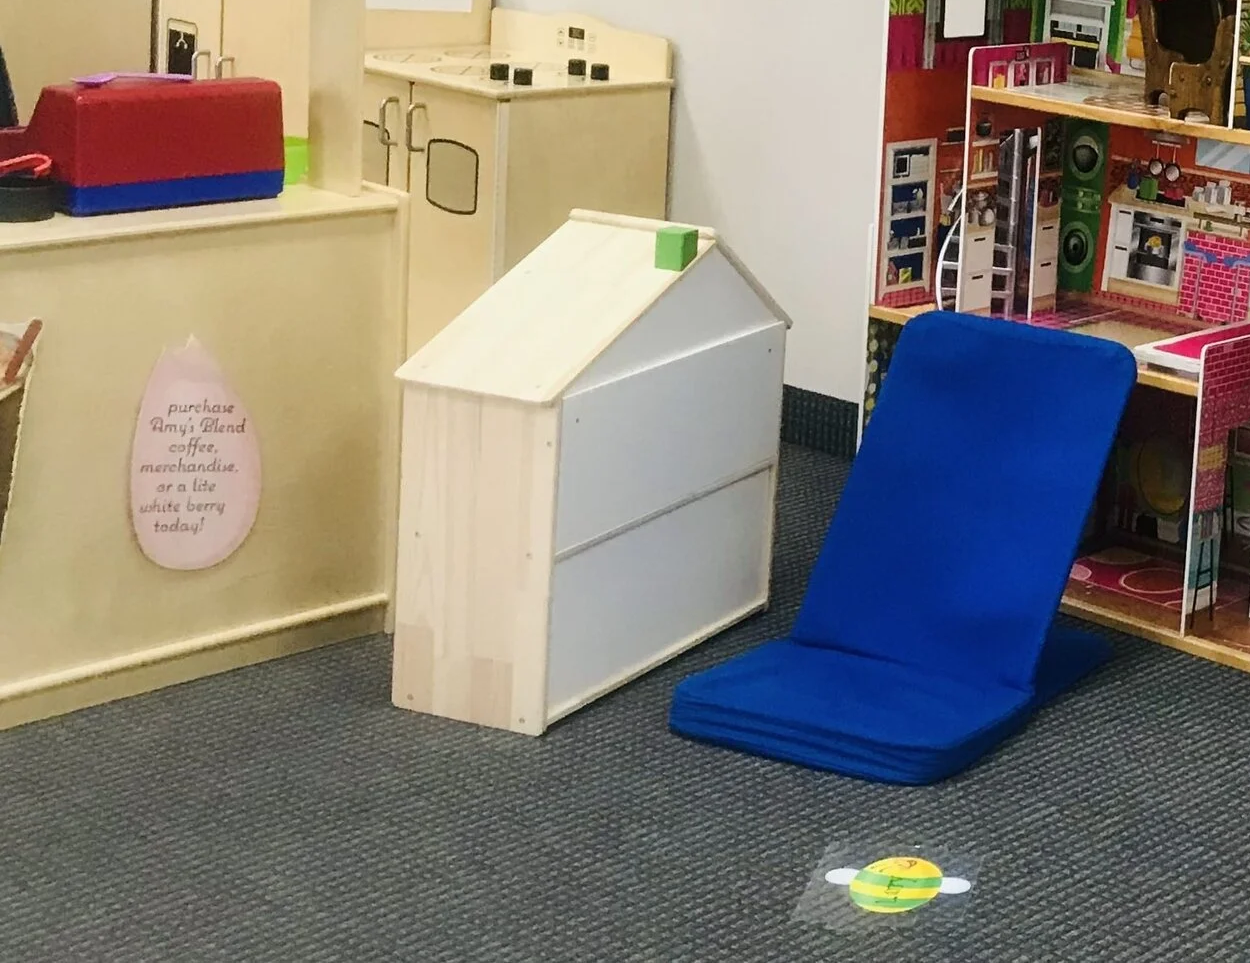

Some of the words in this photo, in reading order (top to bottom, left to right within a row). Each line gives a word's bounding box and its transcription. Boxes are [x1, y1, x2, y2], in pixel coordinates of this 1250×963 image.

[167, 398, 235, 417] purchase
[150, 417, 194, 437] Amy's
[200, 417, 246, 434] Blend
[168, 436, 219, 457] coffee,
[156, 482, 173, 493] or
[177, 482, 187, 493] a
[193, 478, 216, 493] lite
[139, 498, 181, 514] white
[187, 497, 226, 516] berry
[153, 517, 205, 535] today!
